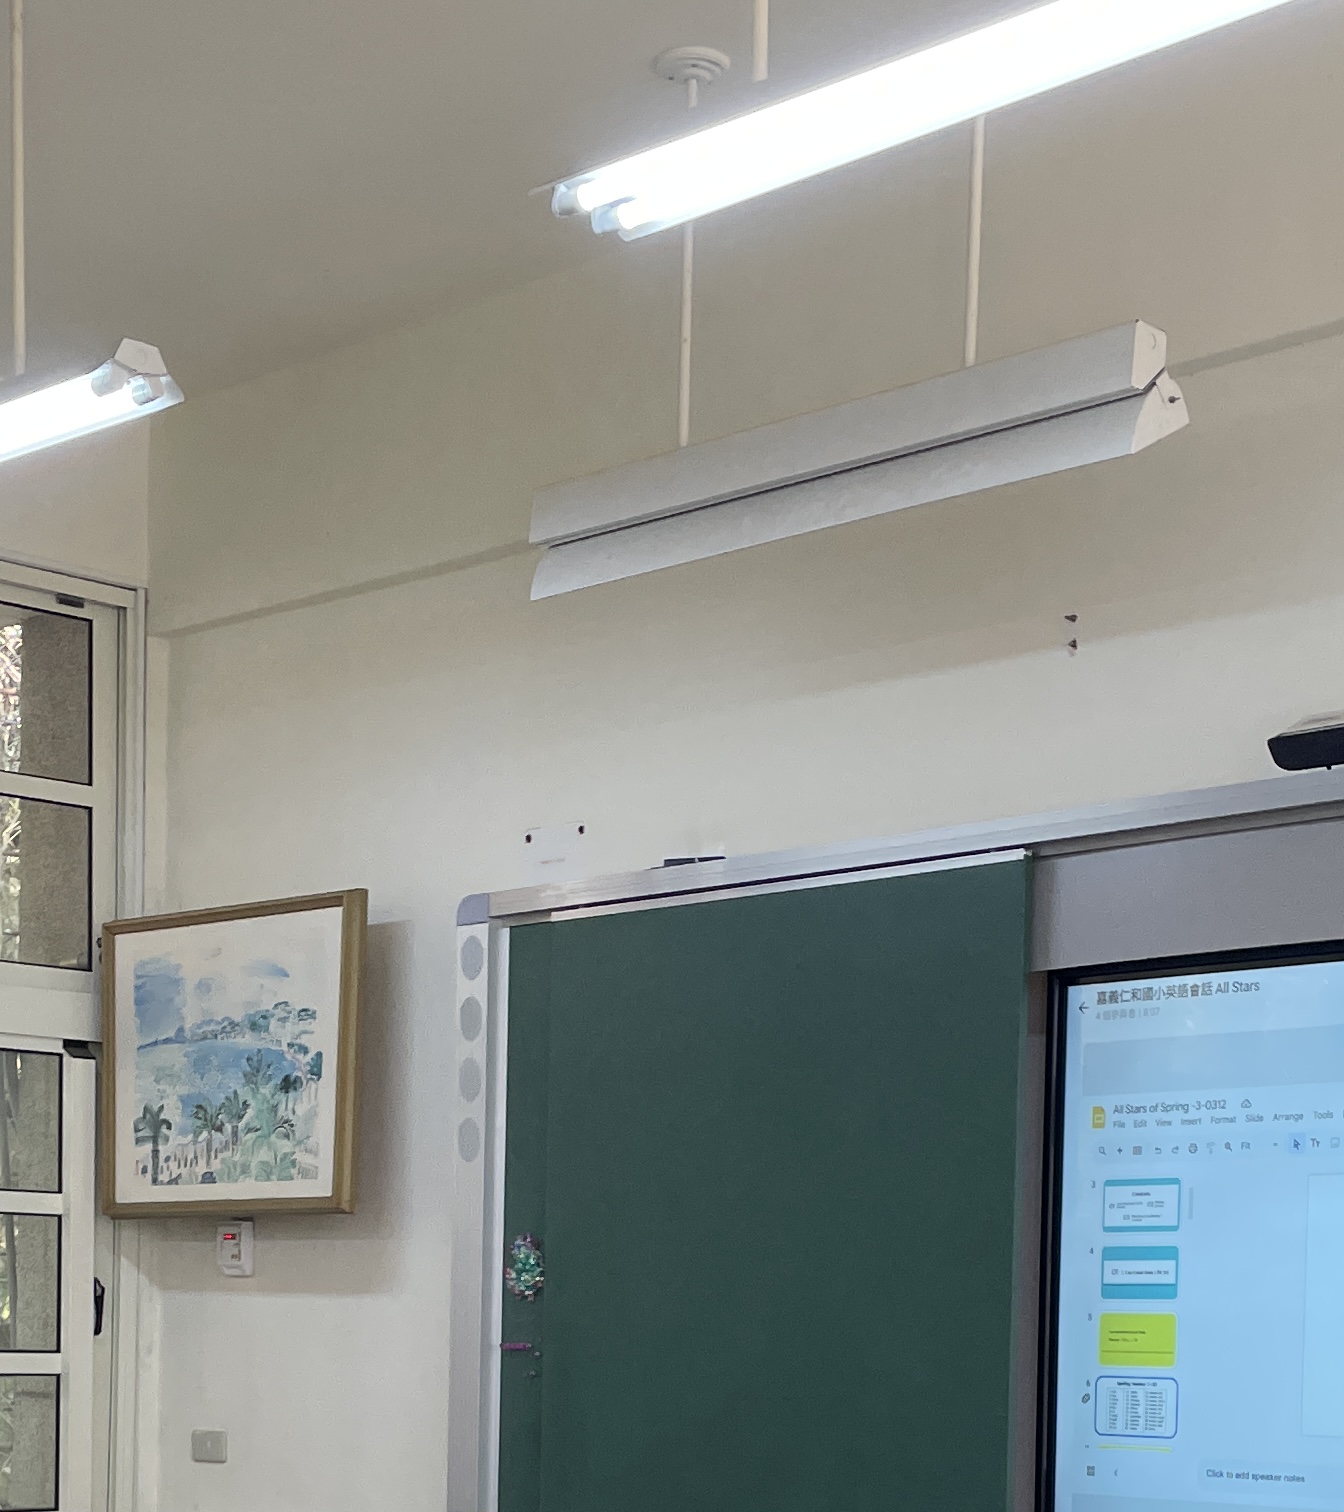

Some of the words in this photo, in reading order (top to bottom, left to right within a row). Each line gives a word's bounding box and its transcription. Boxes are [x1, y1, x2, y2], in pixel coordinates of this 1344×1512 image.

[1096, 983, 1213, 1006] 嘉義仁和國小英語會話
[1215, 982, 1229, 995] All
[1232, 980, 1260, 993] Stars
[1113, 1104, 1123, 1114] All
[1125, 1103, 1147, 1114] Stars
[1149, 1103, 1159, 1113] of
[1160, 1102, 1189, 1114] Spring
[1113, 1120, 1125, 1128] File
[1133, 1120, 1147, 1128] Edit
[1155, 1118, 1172, 1127] View
[1181, 1117, 1202, 1126] Insert
[1210, 1115, 1237, 1125] Format
[1245, 1114, 1264, 1123] Slide
[1272, 1112, 1304, 1122] Arrange
[1313, 1110, 1333, 1120] Tools
[1206, 1468, 1224, 1478] Click
[1226, 1471, 1234, 1479] to
